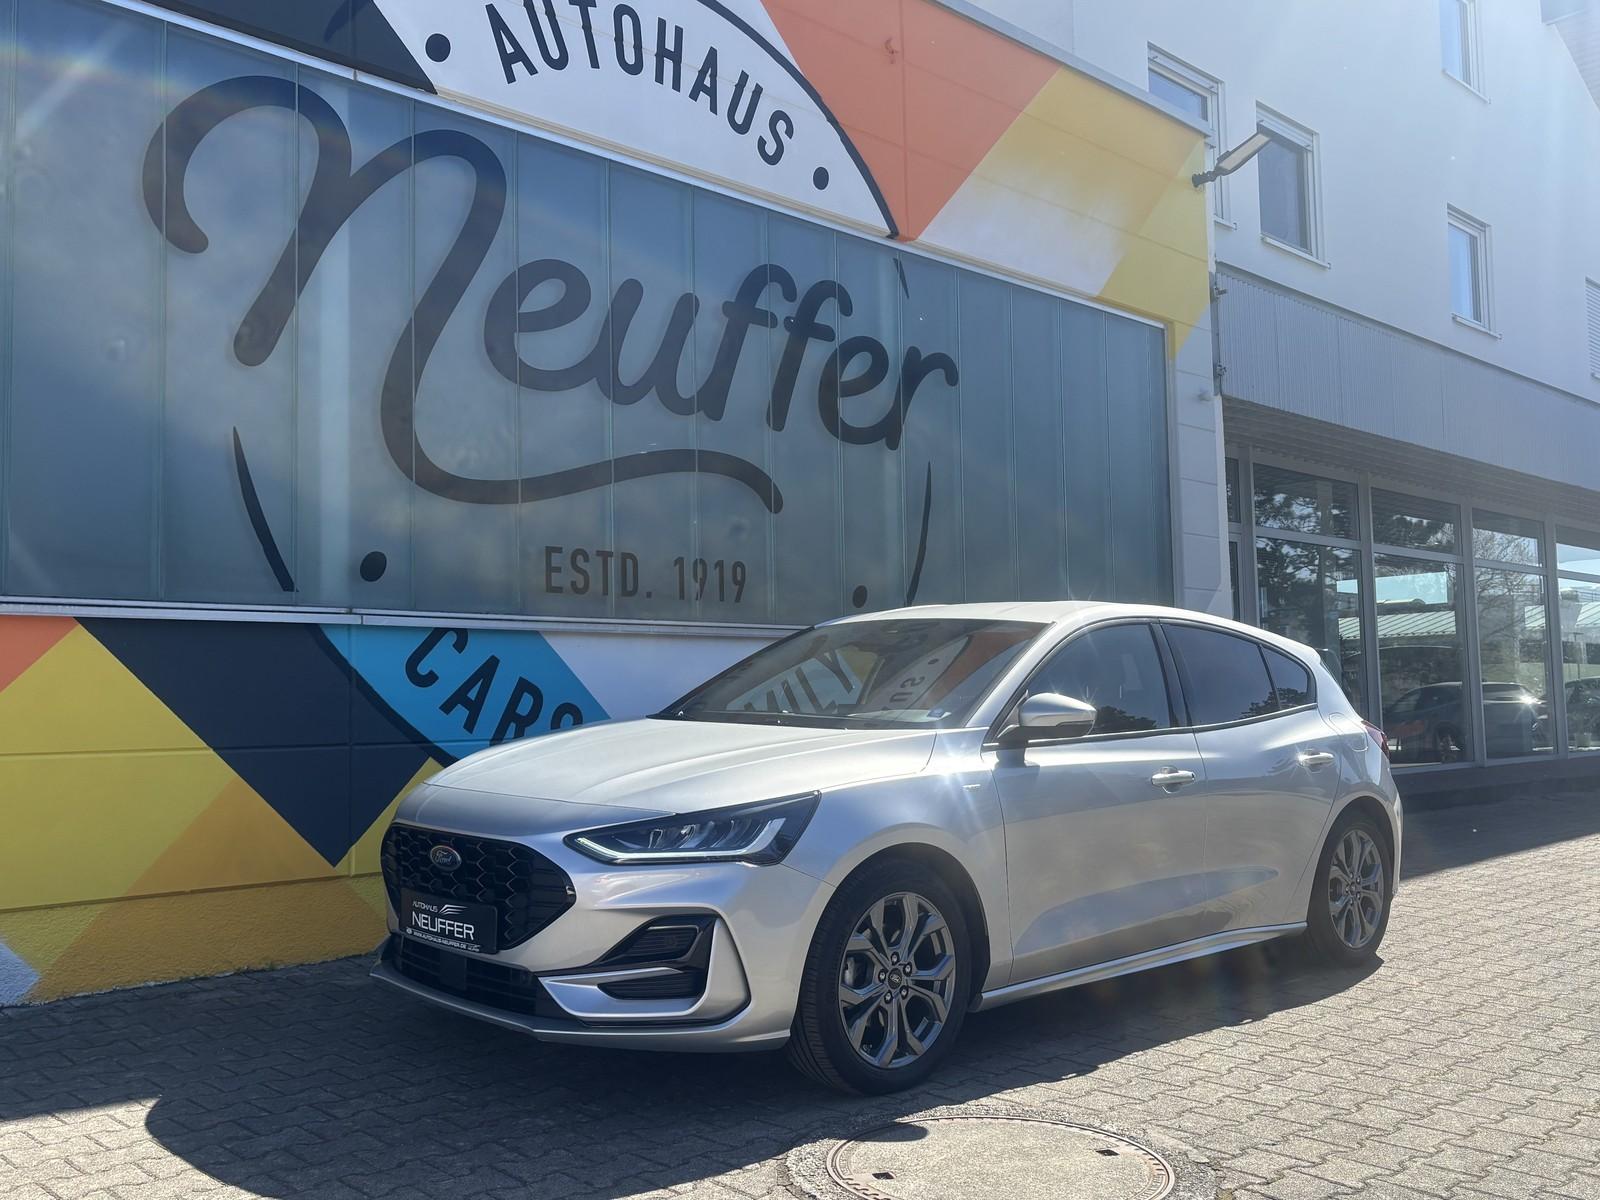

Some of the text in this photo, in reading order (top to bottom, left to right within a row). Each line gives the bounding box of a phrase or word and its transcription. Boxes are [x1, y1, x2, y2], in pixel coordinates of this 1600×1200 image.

[485, 0, 794, 166] AUTOHAUS
[142, 75, 960, 515] Neuffer
[544, 545, 747, 603] ESTD. 1919
[412, 901, 438, 913] AUTOHAUS
[412, 911, 475, 940] NEUFFER
